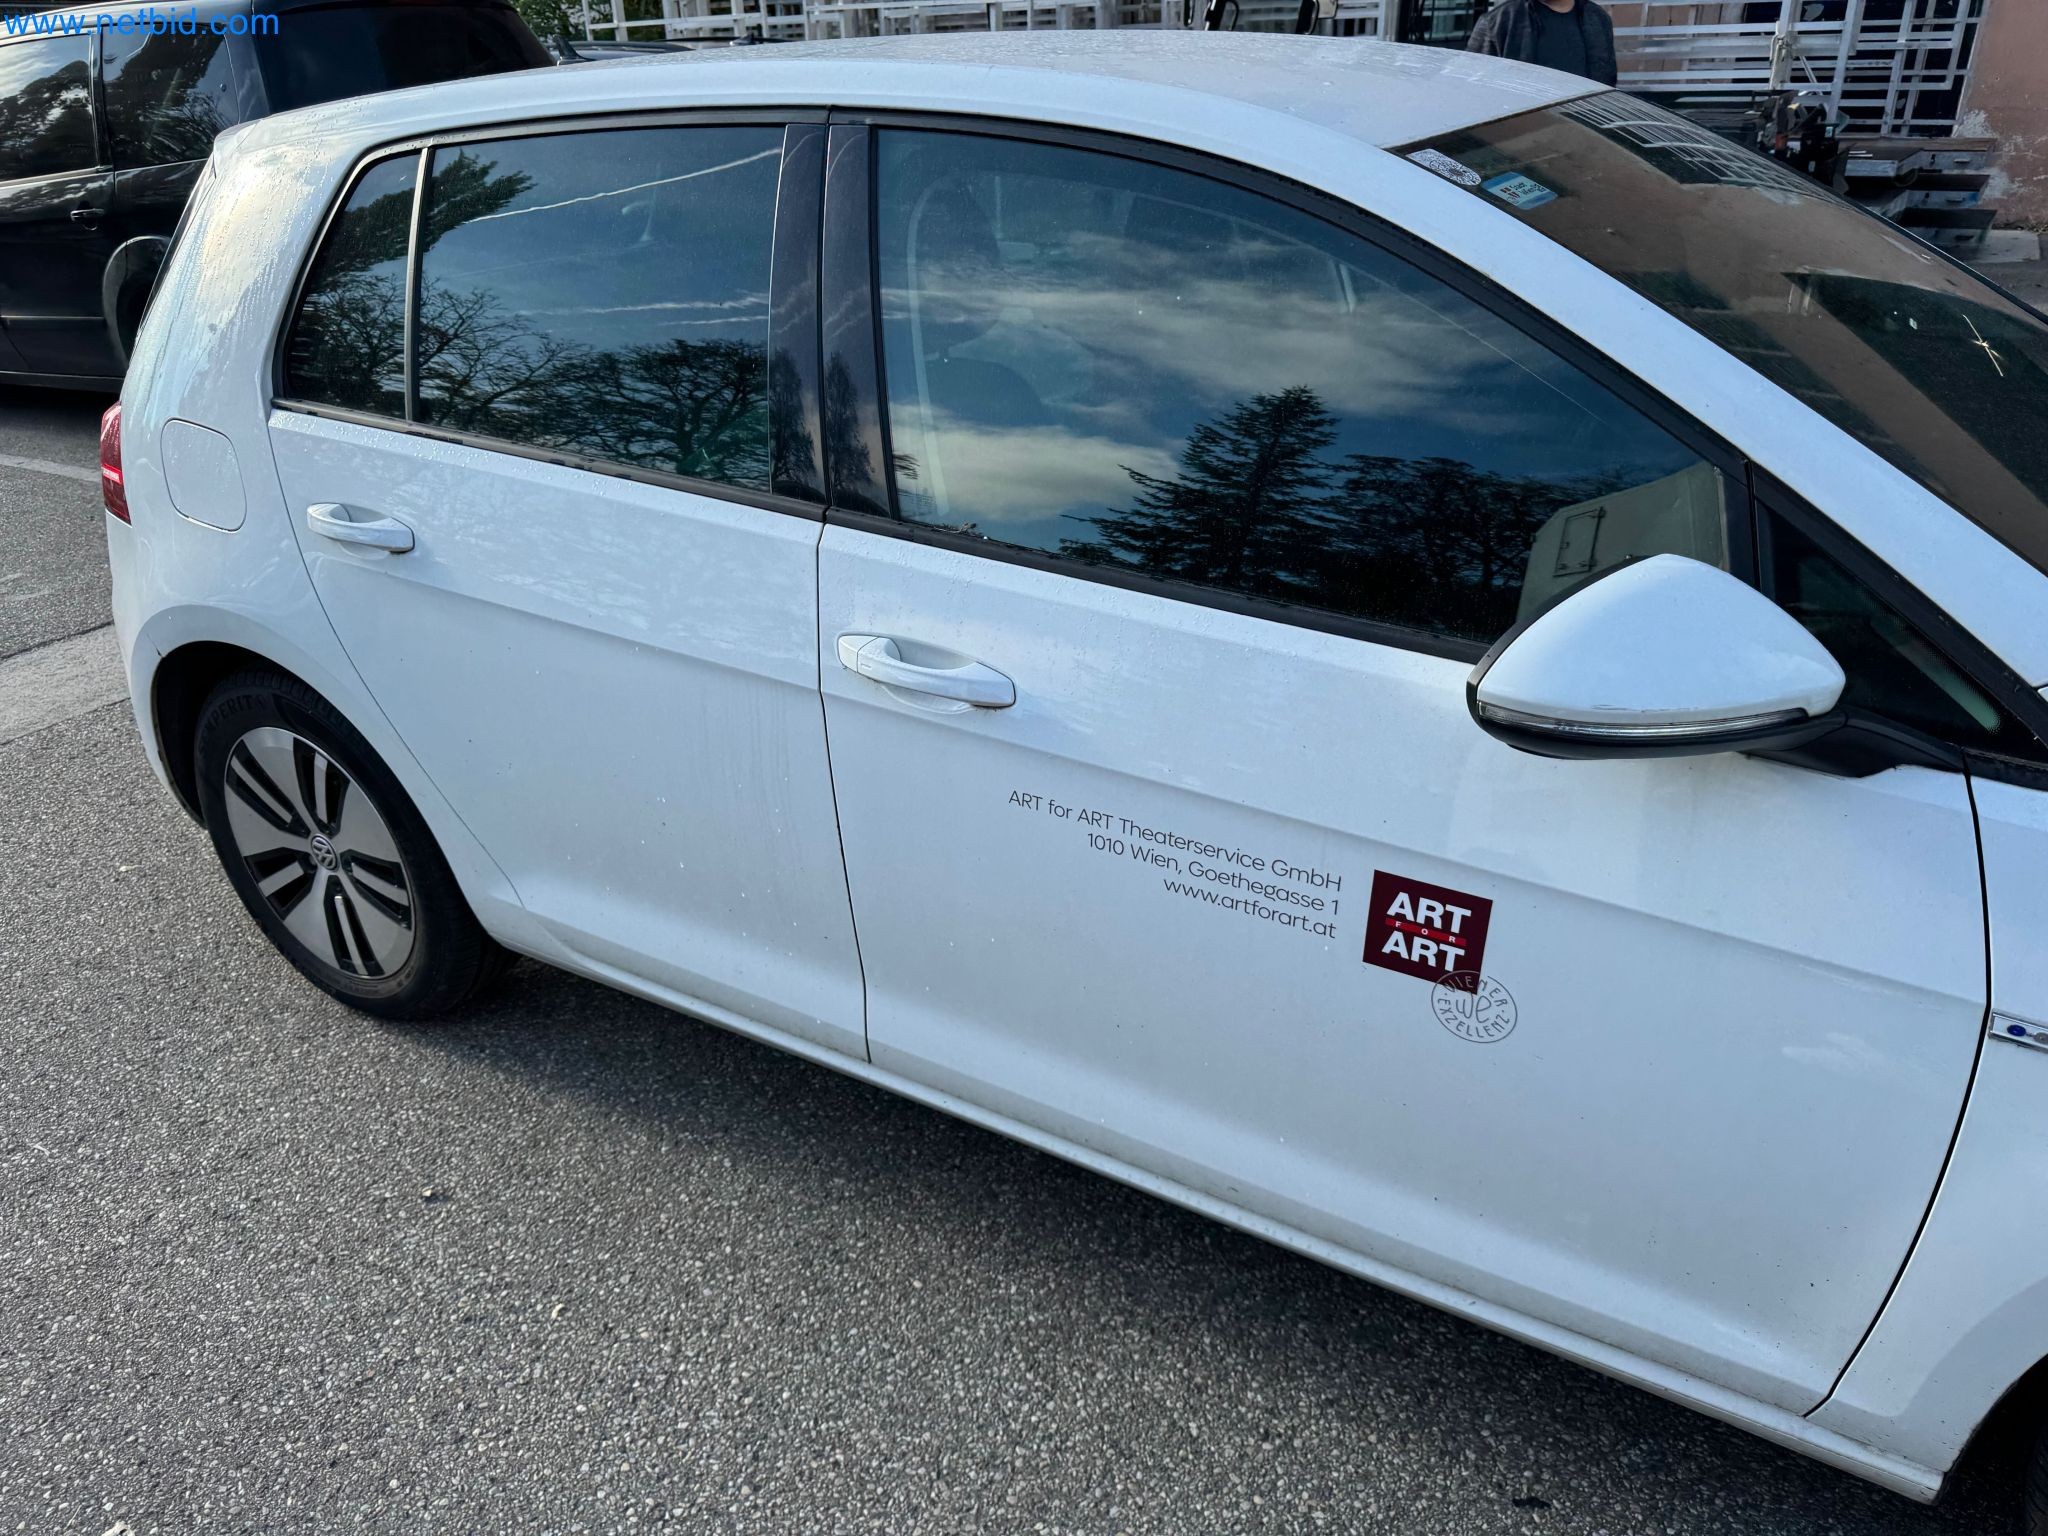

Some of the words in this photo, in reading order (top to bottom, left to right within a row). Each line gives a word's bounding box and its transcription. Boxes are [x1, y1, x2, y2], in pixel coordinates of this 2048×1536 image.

[1008, 790, 1043, 811] ART
[1048, 799, 1073, 819] for
[1077, 808, 1114, 829] ART
[1119, 817, 1265, 871] Theaterservice
[1271, 859, 1342, 892] GmbH
[1088, 833, 1125, 856] 1010
[1130, 843, 1182, 875] Wien,
[1188, 861, 1325, 911] Goethegasse
[1331, 899, 1340, 915] 1
[1164, 879, 1337, 939] www.artforart.at
[1386, 891, 1472, 934] ART
[1395, 921, 1456, 943] FOR
[1381, 930, 1466, 972] ART
